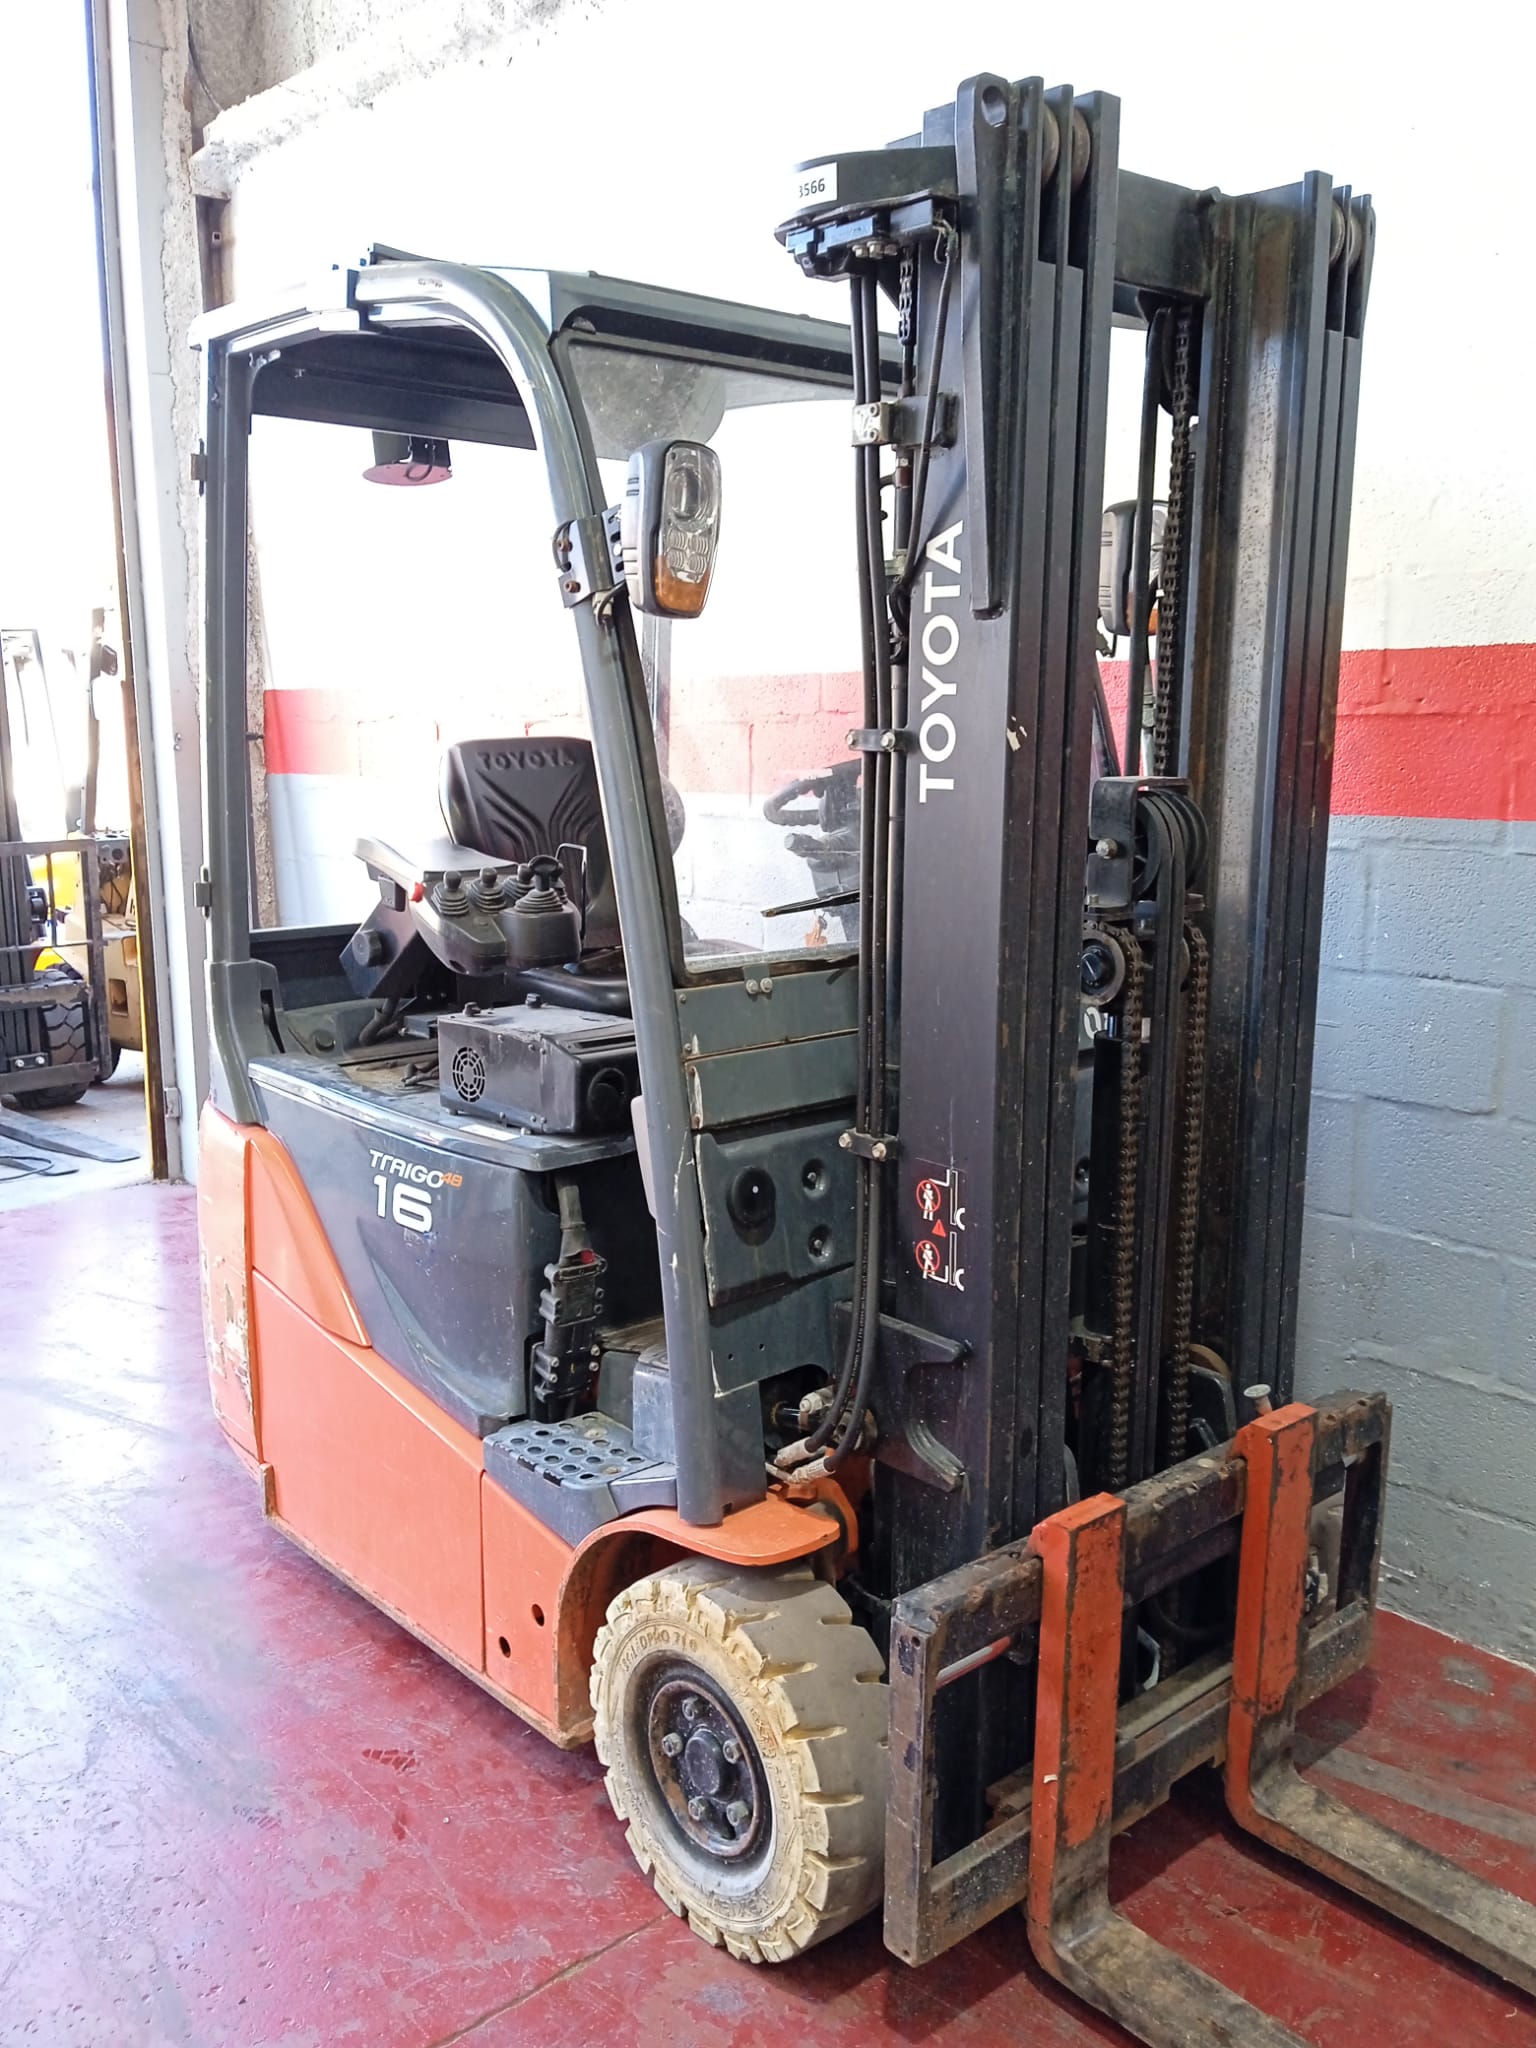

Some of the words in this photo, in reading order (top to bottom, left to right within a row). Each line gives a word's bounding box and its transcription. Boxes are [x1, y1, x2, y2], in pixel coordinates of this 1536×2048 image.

[919, 520, 964, 804] TOYOTA
[475, 748, 575, 771] TOYOTA
[374, 1175, 432, 1233] 16
